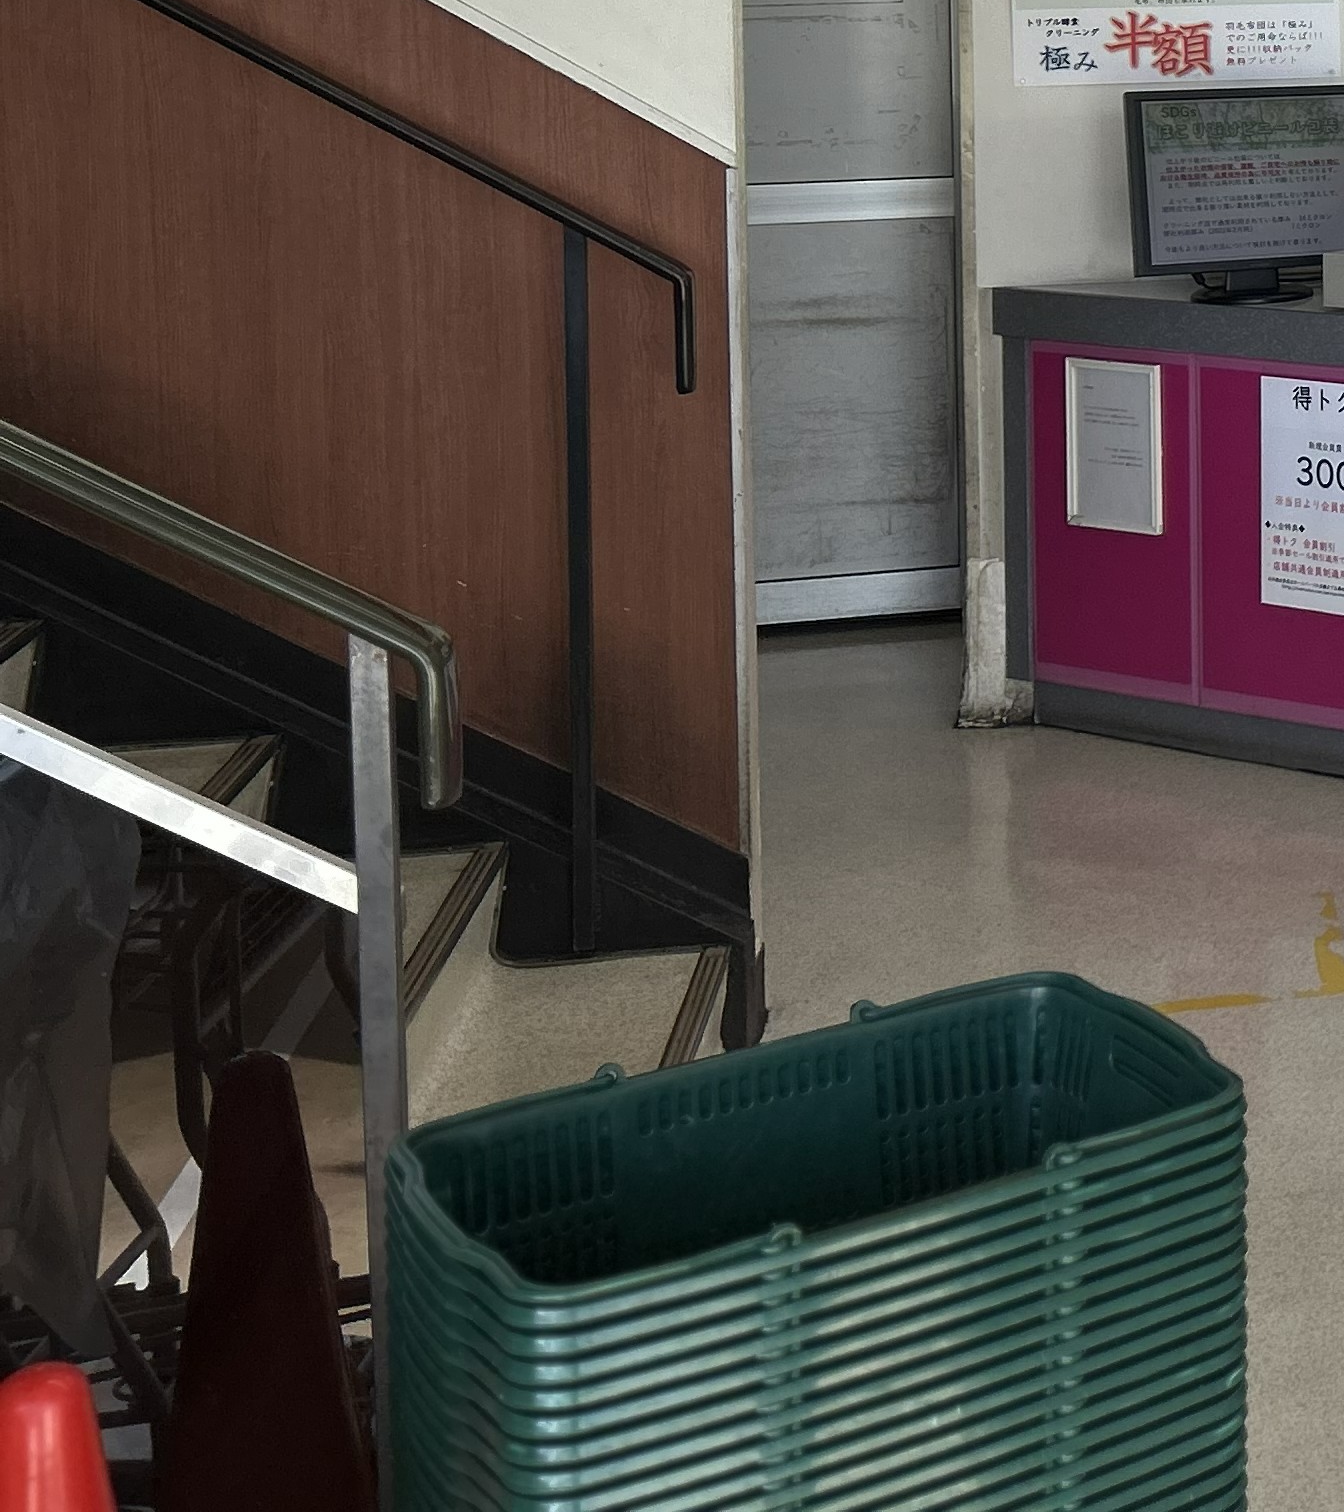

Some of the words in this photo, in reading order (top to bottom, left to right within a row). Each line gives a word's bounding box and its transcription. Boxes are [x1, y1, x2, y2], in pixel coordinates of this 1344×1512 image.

[1046, 28, 1100, 37] クリーニング
[1104, 11, 1215, 77] 半額
[1040, 46, 1098, 72] 極み
[1161, 106, 1197, 118] SDGs
